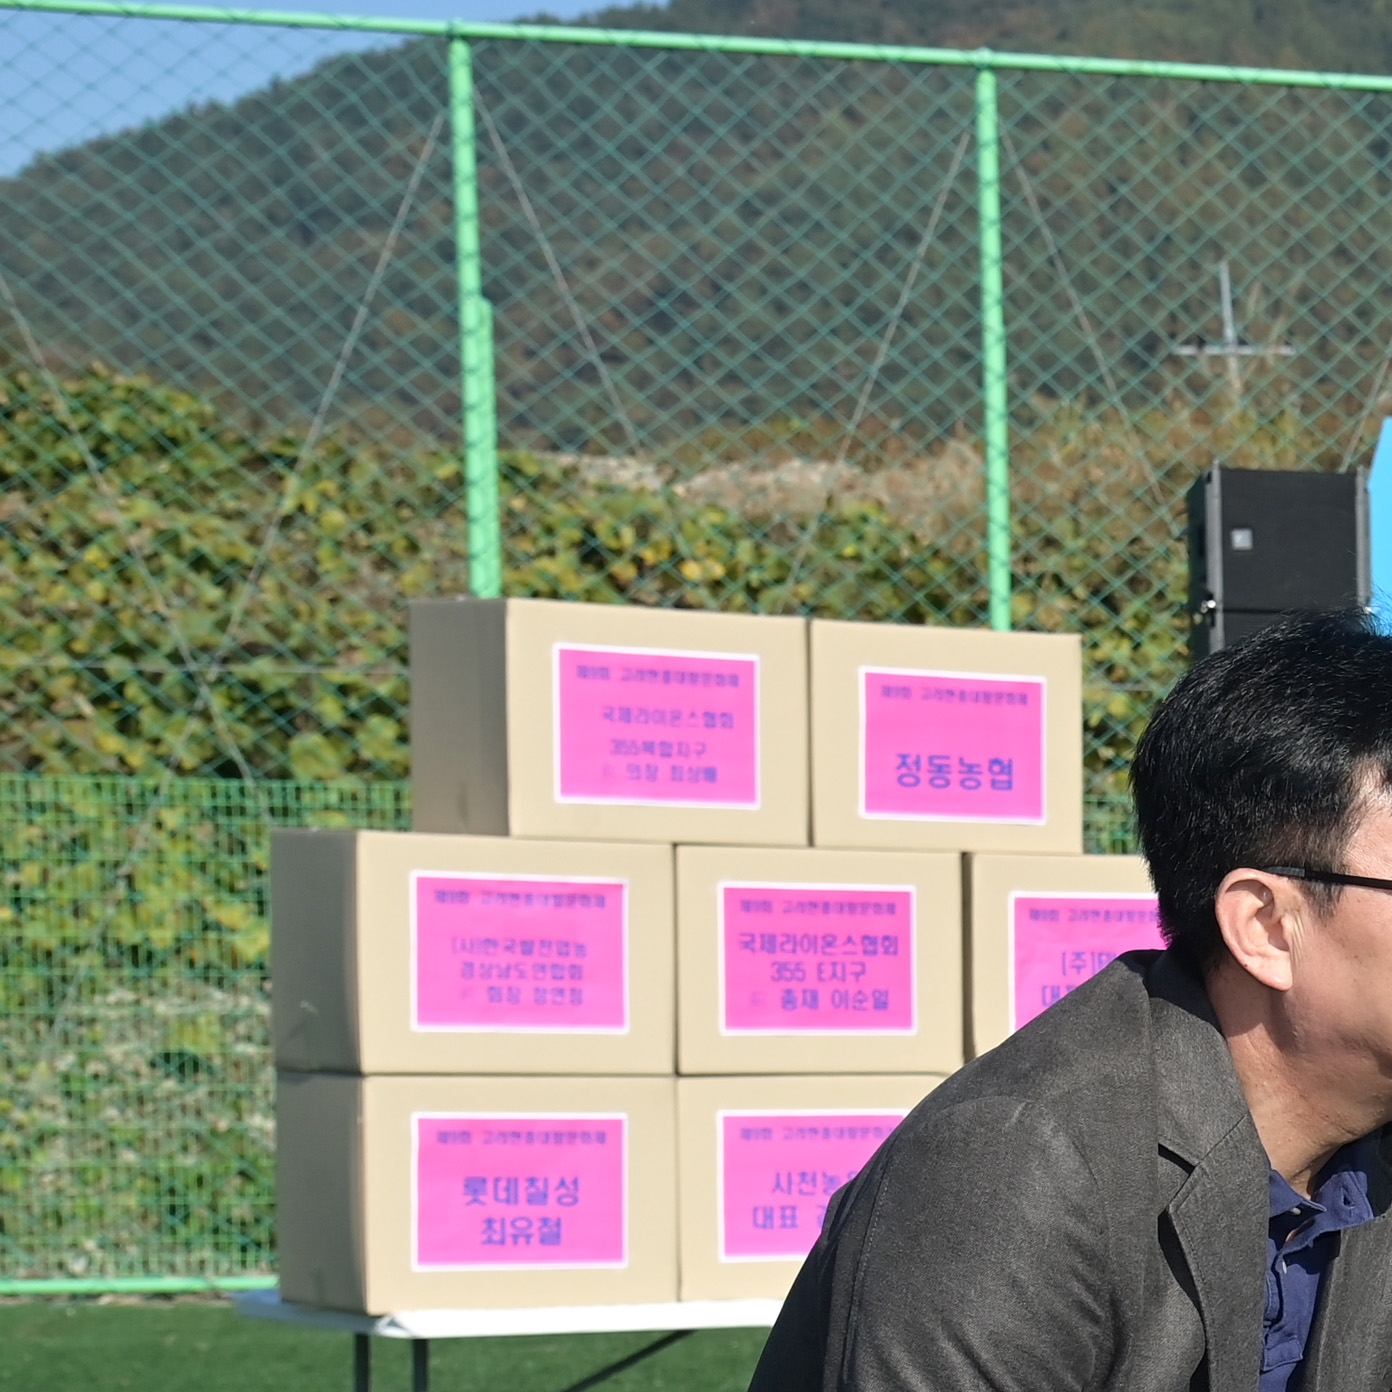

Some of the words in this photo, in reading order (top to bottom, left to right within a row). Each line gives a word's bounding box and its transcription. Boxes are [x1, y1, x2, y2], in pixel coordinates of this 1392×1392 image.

[895, 753, 1014, 791] 정동농협
[738, 932, 900, 957] 국제라이온스협회
[770, 960, 807, 983] 355
[780, 987, 820, 1012] 총재
[831, 988, 890, 1012] 이순일
[462, 1175, 581, 1208] 롯데칠성
[752, 1204, 800, 1230] 대표
[480, 1215, 563, 1246] 최유철
